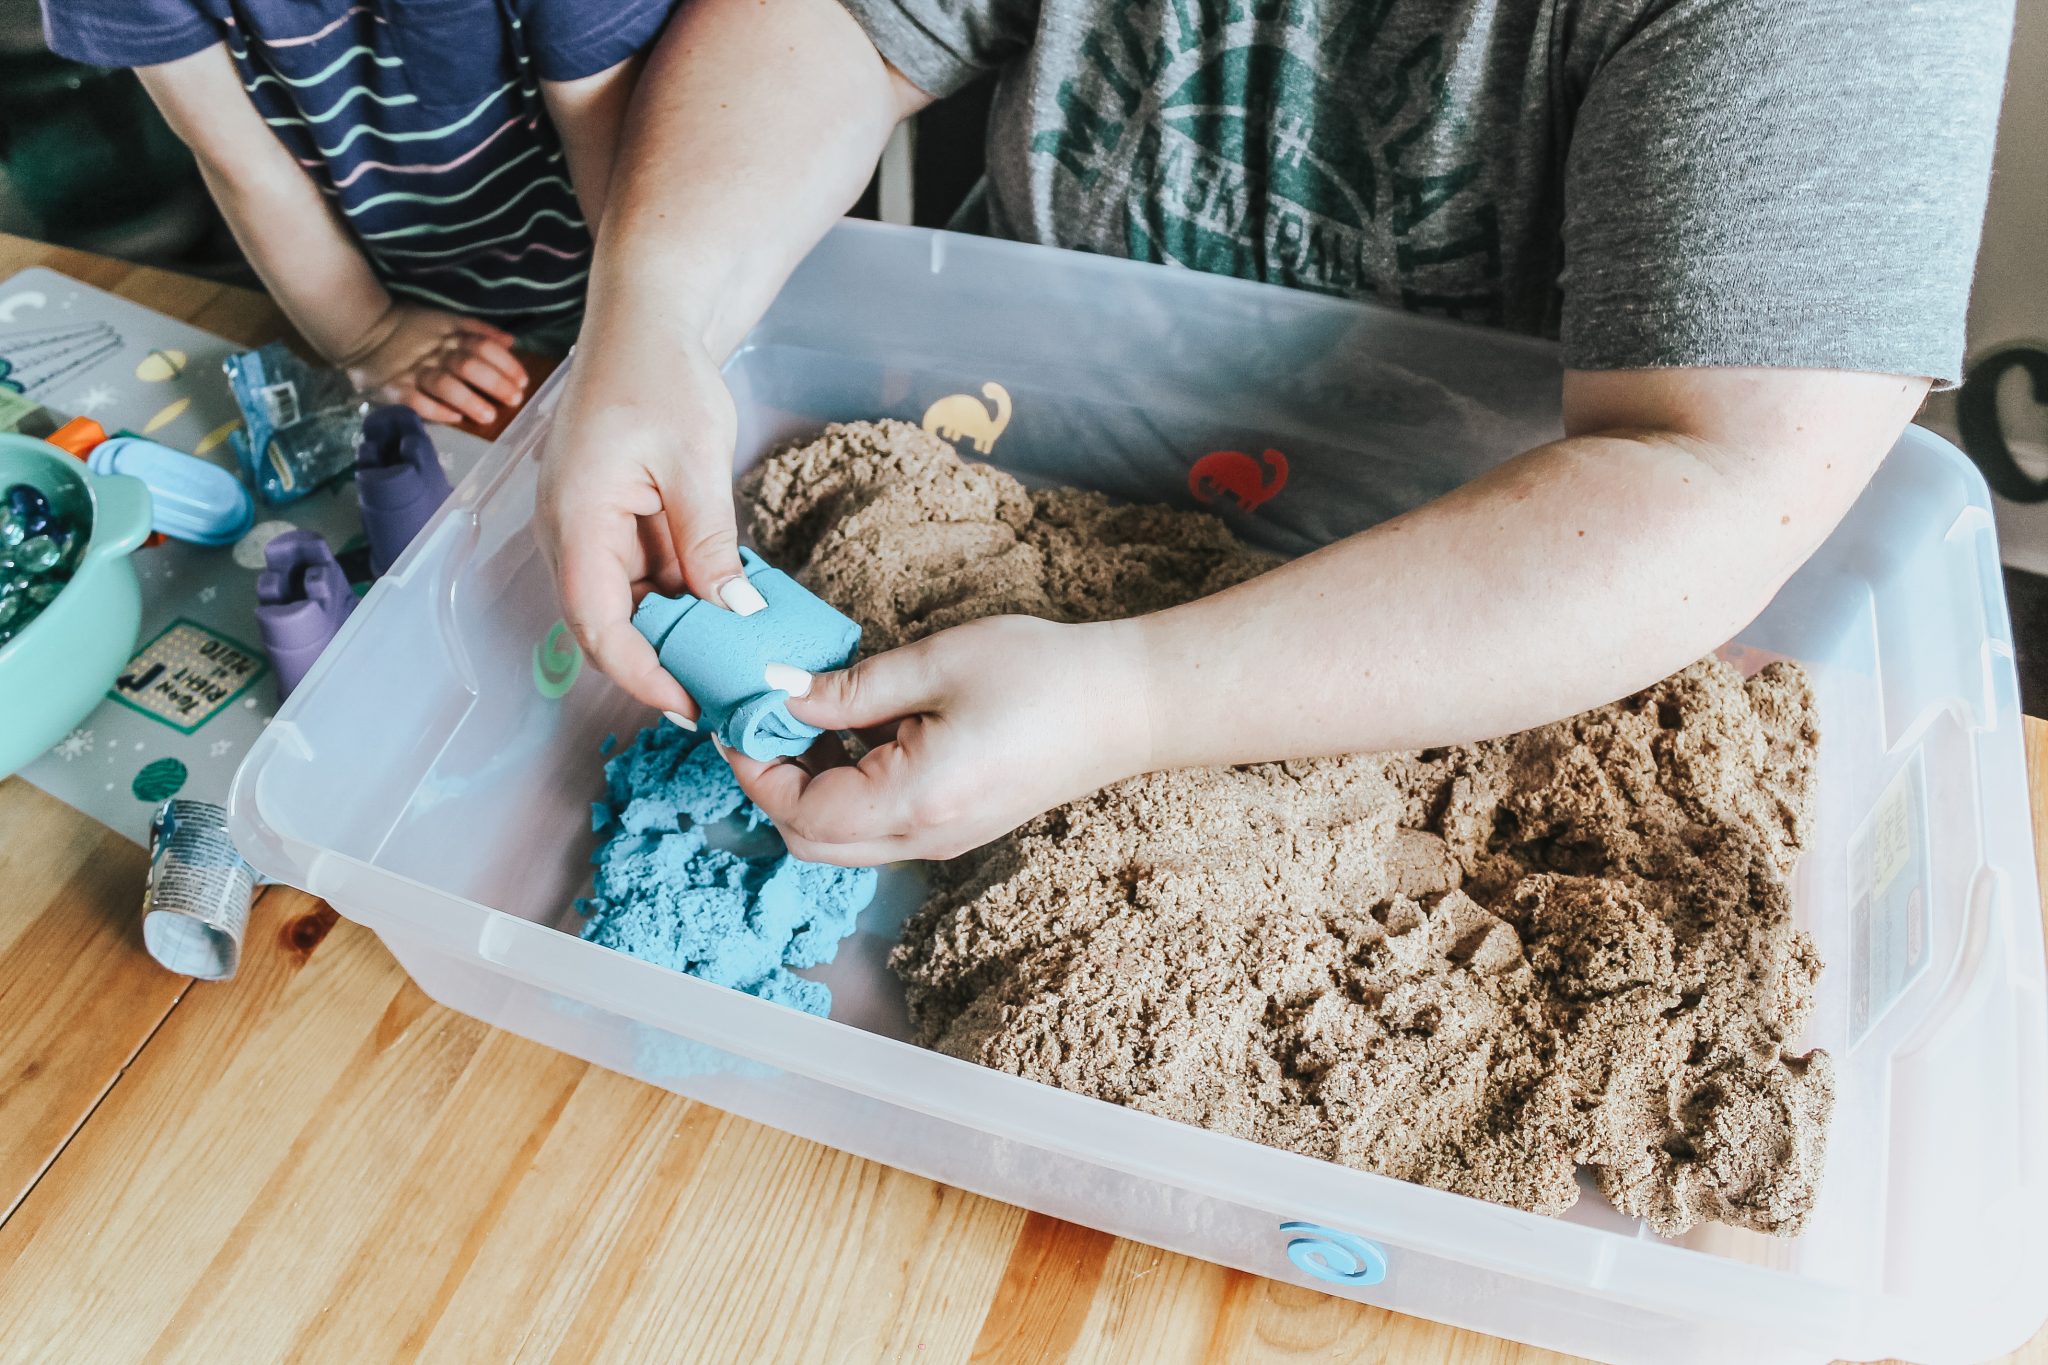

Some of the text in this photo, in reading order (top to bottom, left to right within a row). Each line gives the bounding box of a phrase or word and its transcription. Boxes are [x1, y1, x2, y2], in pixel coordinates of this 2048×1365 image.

[198, 640, 256, 675] PLUTO
[155, 681, 200, 715] TURN
[173, 667, 228, 703] RIGHT
